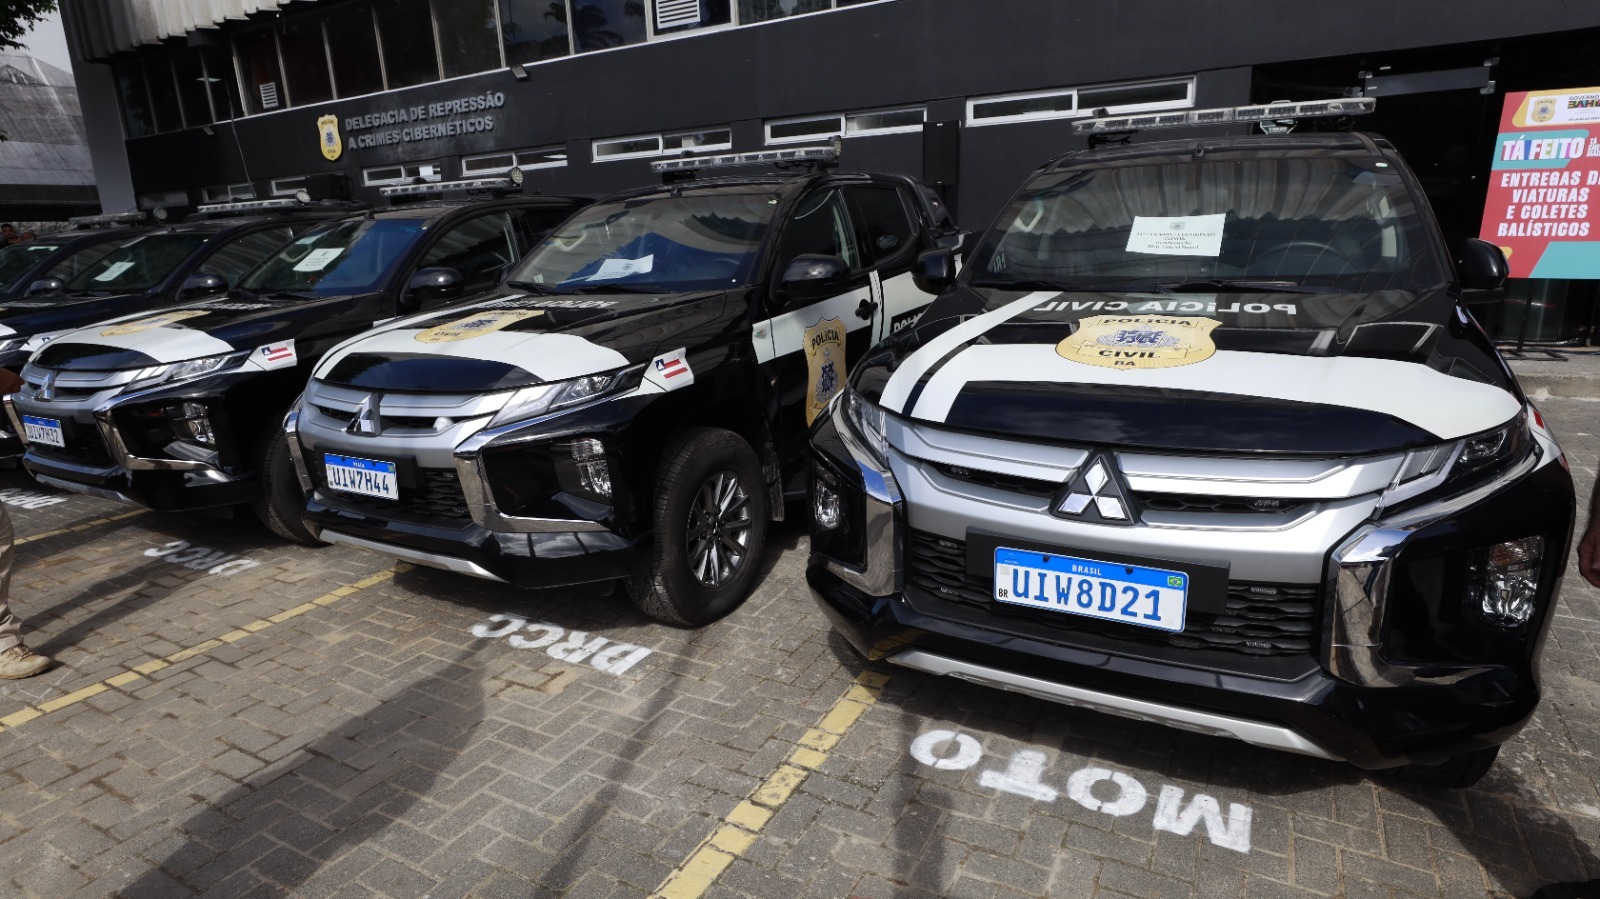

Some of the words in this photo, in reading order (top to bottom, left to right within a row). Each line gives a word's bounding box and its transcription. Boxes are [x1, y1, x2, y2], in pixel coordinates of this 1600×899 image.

[345, 110, 407, 131] DELEGACIA
[410, 106, 427, 121] DE
[428, 91, 505, 118] REPRESSÃO
[347, 136, 358, 150] A
[357, 131, 401, 149] CRIMES
[401, 116, 494, 143] CIBERNÉTICOS
[1502, 134, 1526, 161] TÁ
[1528, 137, 1586, 160] FEITO
[1501, 171, 1582, 187] ENTREGAS
[1587, 170, 1600, 185] D
[1512, 187, 1590, 203] VIATURAS
[1506, 205, 1516, 220] E
[1520, 204, 1589, 219] COLETES
[1497, 219, 1591, 237] BALÍSTICOS
[1098, 349, 1161, 359] CIVIL
[332, 466, 390, 495] UIW7H44
[1071, 564, 1102, 576] BRASIL
[998, 587, 1009, 599] BR
[1012, 568, 1163, 622] UIW8D21
[910, 729, 1254, 854] MOTO
